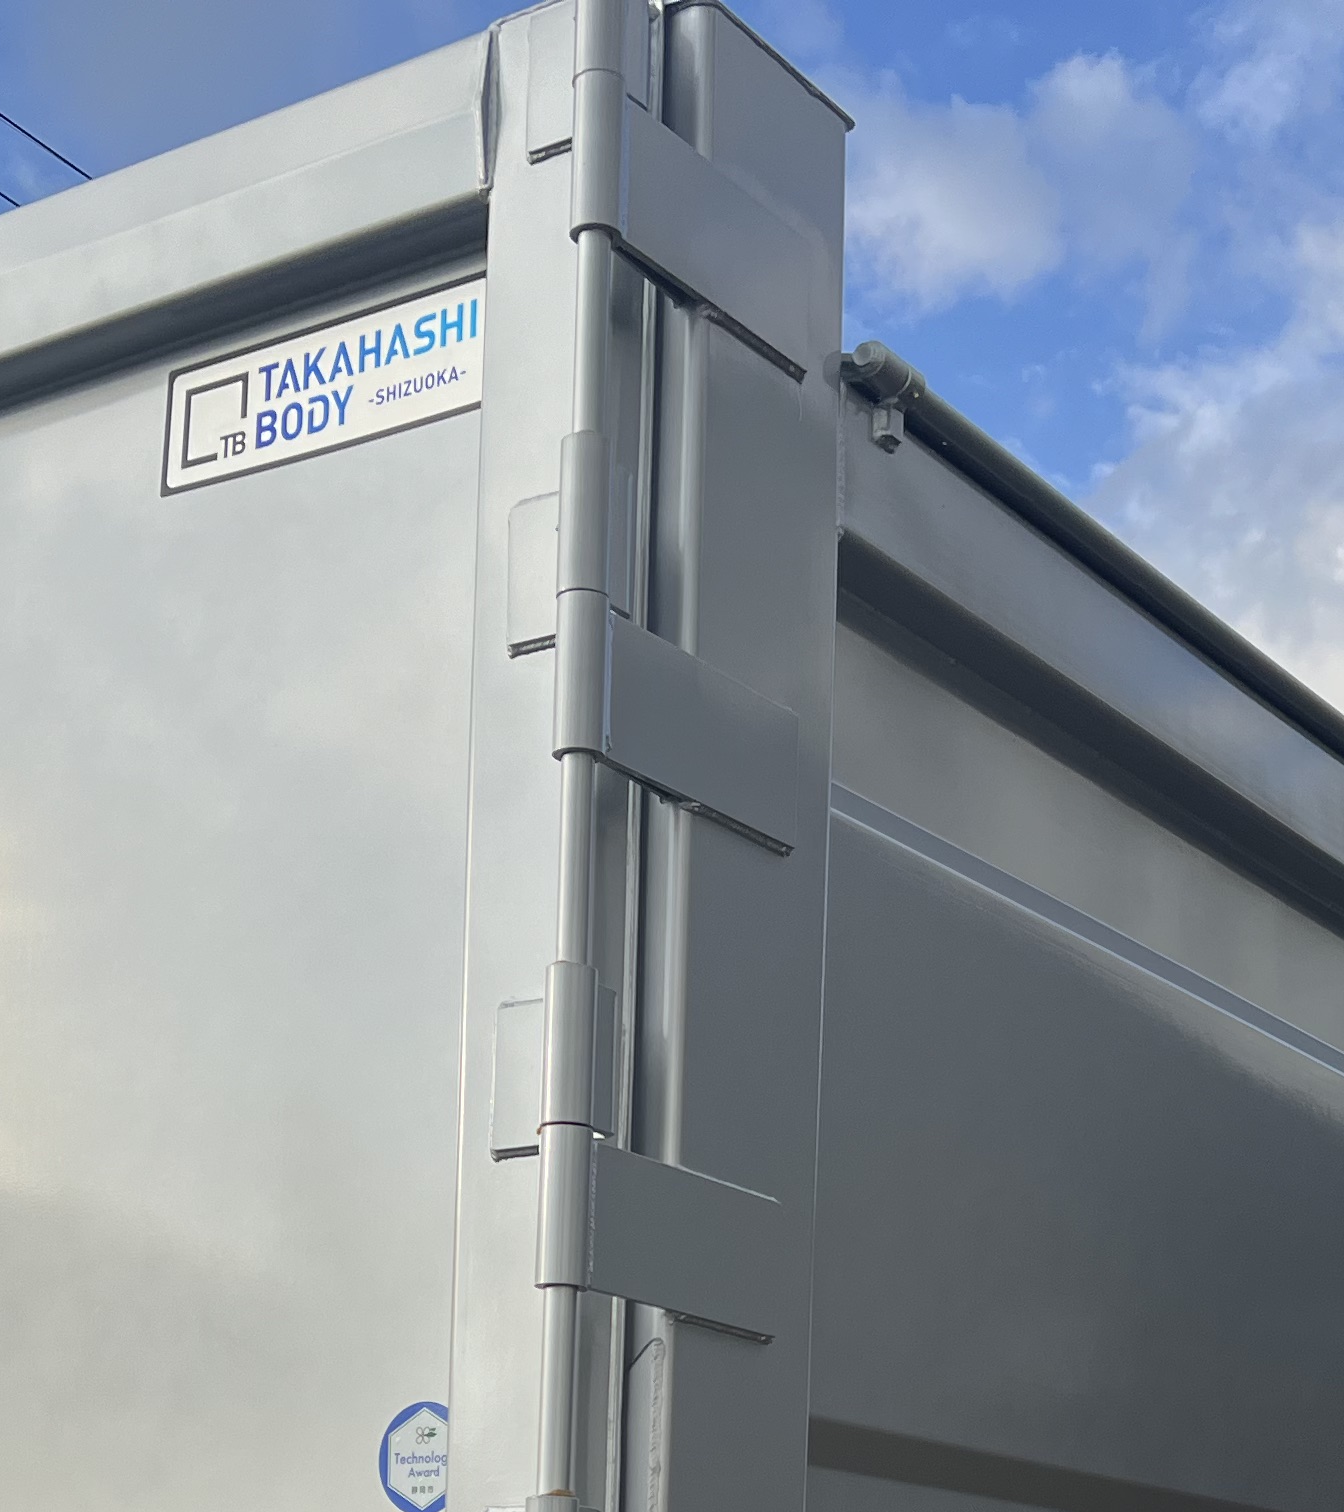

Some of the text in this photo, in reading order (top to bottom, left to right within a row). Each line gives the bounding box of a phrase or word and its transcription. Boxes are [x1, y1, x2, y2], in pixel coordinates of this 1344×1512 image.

[258, 298, 478, 402] TAKAHASHI
[255, 366, 467, 450] BODY -SHIZUOKA-
[219, 430, 246, 458] TB
[394, 1450, 448, 1467] Technolog
[408, 1465, 440, 1478] Award
